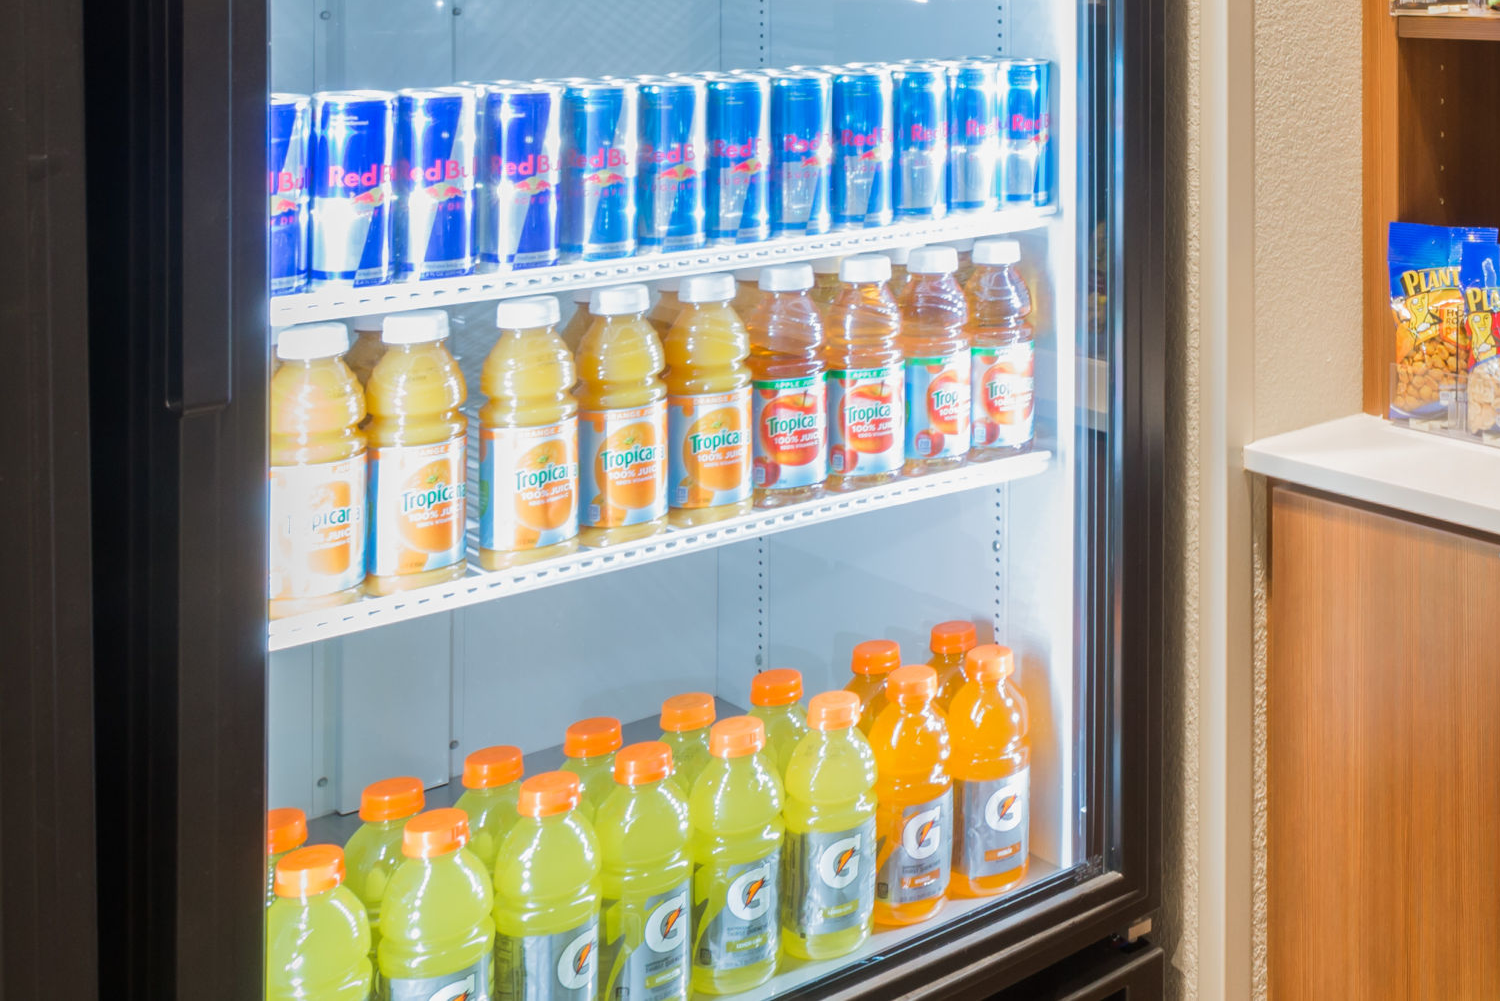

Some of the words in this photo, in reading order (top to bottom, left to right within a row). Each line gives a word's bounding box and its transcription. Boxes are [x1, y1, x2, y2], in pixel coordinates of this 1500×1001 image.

[783, 132, 821, 152] Red
[841, 127, 877, 146] Red
[643, 143, 681, 163] Red
[713, 136, 752, 158] Red
[491, 154, 533, 175] Red
[567, 148, 604, 168] Red
[329, 163, 377, 187] Red
[775, 380, 800, 390] APPLE
[851, 423, 876, 434] 100%
[774, 434, 799, 445] 100%
[697, 451, 724, 462] 100%
[608, 469, 635, 481] 100%
[522, 488, 548, 501] 100%
[985, 783, 1022, 831] G
[902, 806, 941, 859] G
[820, 834, 861, 888] G
[727, 862, 771, 921] G
[645, 890, 687, 953] G
